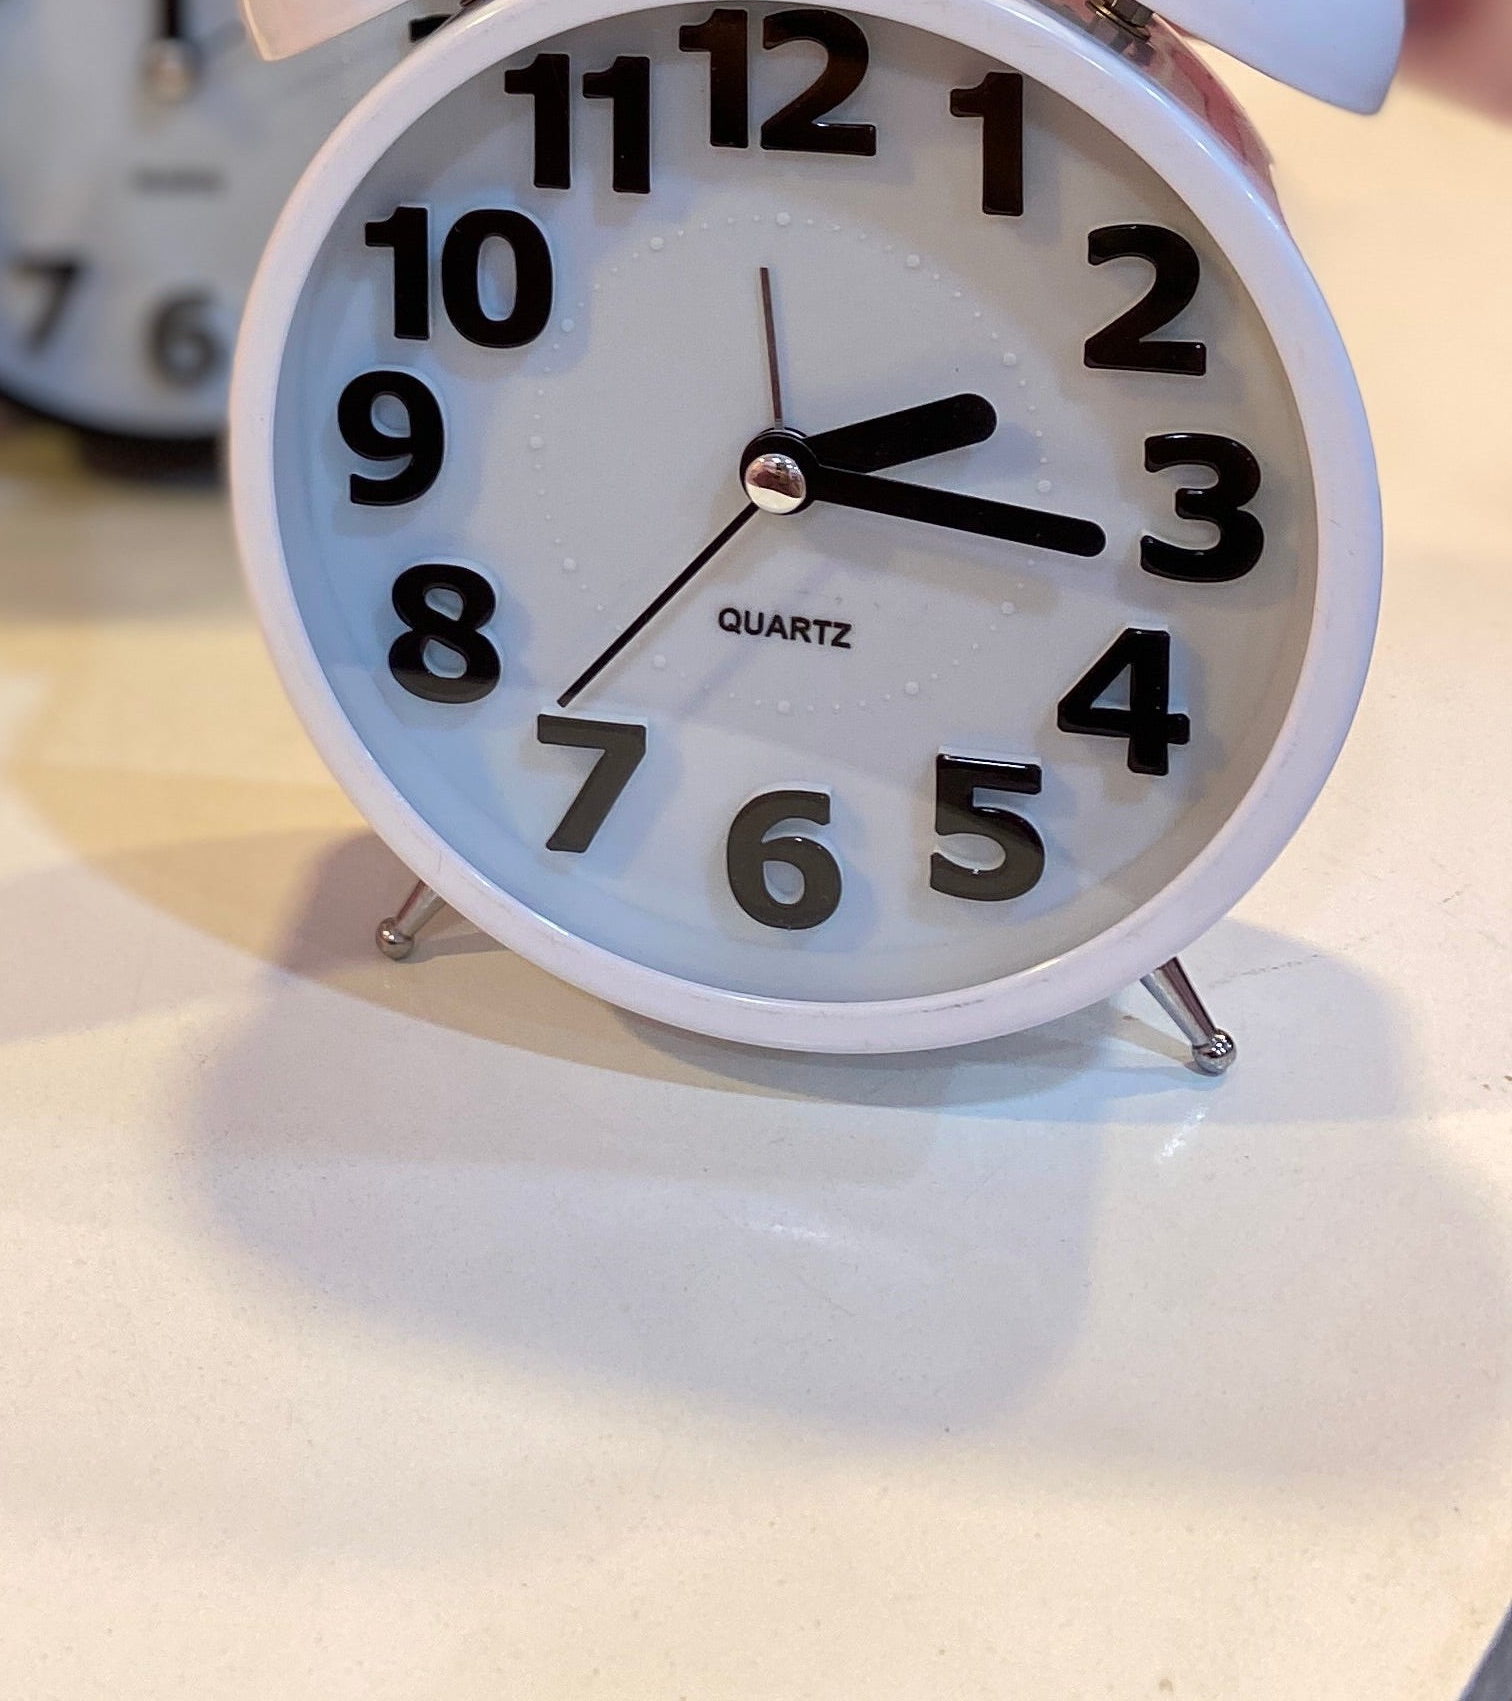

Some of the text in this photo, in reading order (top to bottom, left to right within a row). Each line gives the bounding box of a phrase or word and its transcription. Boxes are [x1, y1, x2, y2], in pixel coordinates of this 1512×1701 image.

[505, 53, 651, 194] 11
[678, 8, 877, 155] 12
[949, 72, 1024, 217] 1
[13, 252, 85, 352] 7
[147, 287, 228, 389] 6
[364, 206, 554, 349] 10
[1084, 224, 1207, 376] 2
[337, 370, 444, 507] 9
[1140, 433, 1265, 583] 3
[388, 564, 501, 704] 8
[717, 607, 853, 649] QUARTZ
[1057, 628, 1190, 776] 4
[537, 714, 646, 853] 7
[930, 754, 1045, 901] 5
[727, 790, 841, 930] 6
